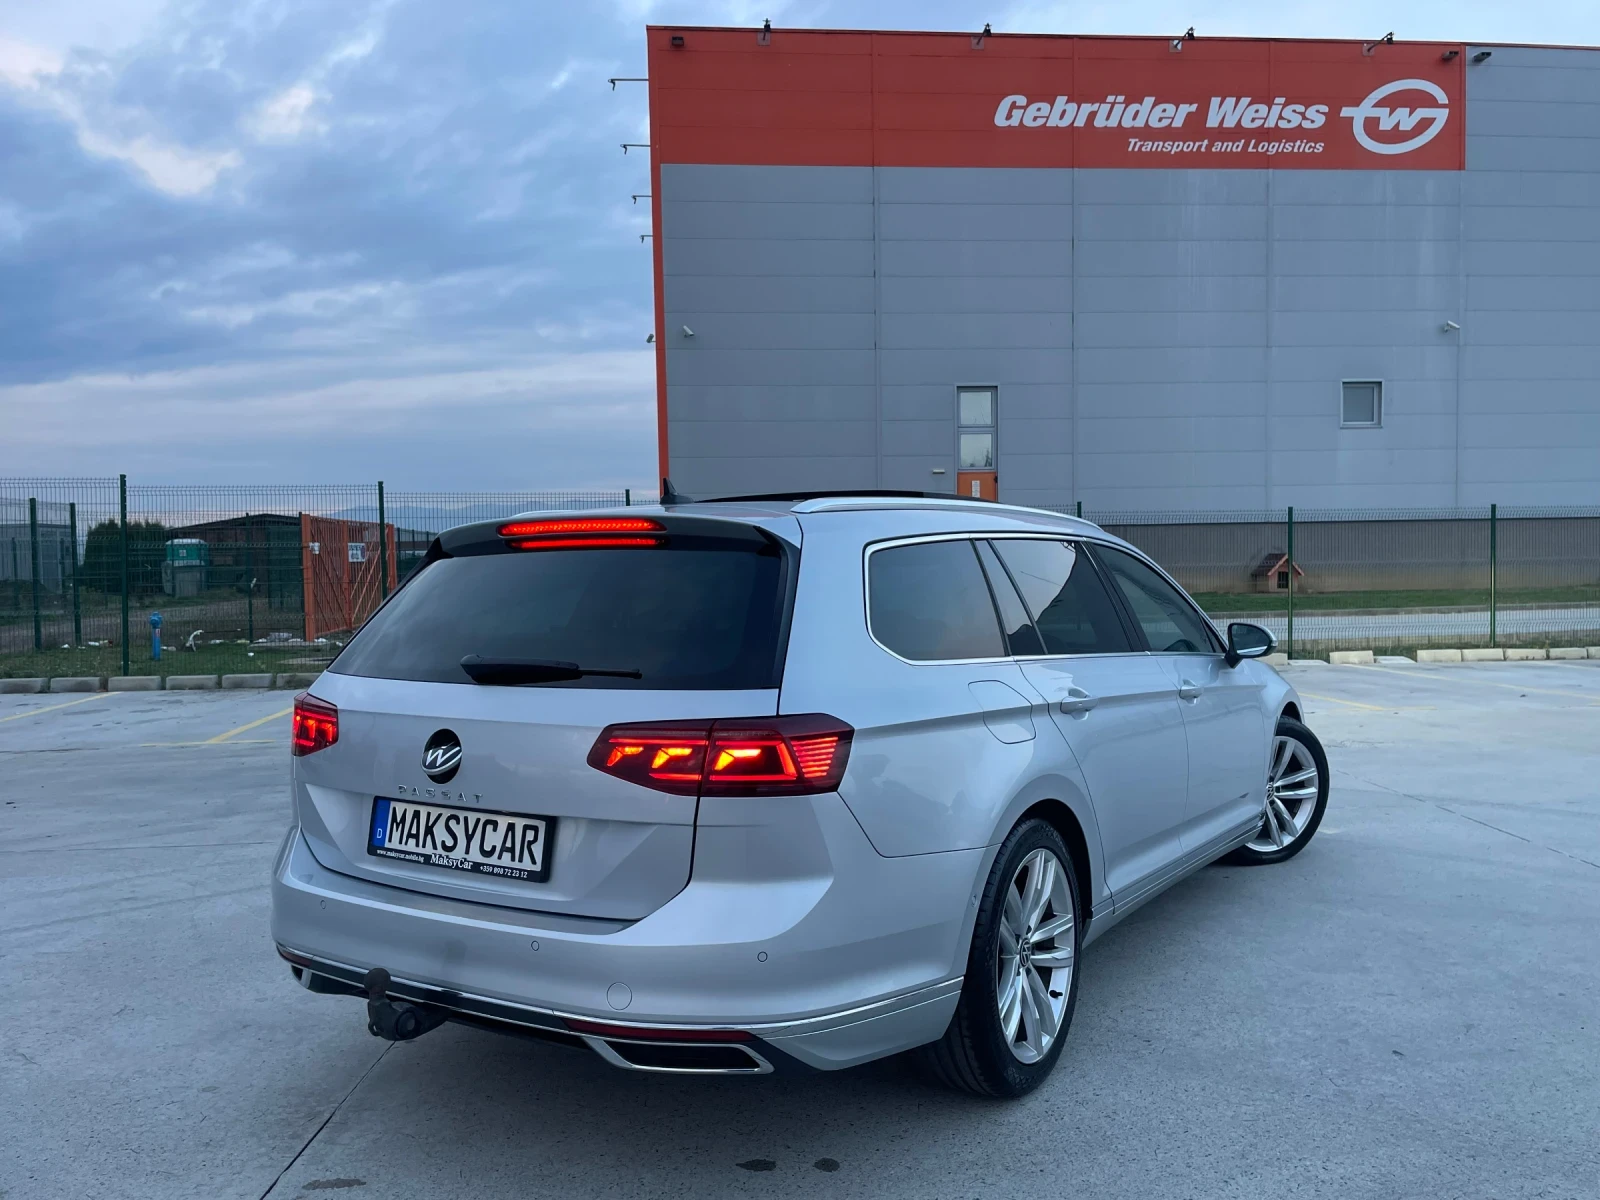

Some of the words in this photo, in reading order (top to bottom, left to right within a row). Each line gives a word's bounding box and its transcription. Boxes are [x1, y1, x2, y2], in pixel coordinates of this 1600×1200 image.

[994, 94, 1198, 128] Gebrüder
[1206, 97, 1329, 129] Weiss
[1127, 138, 1209, 155] Transport
[1212, 140, 1243, 153] and
[1247, 140, 1325, 155] Logistics
[398, 785, 482, 803] PASSAT
[376, 829, 383, 838] D
[388, 806, 540, 866] MAKSYCAR
[430, 853, 473, 869] MaksyCar
[480, 865, 493, 873] +359
[504, 868, 512, 877] 72
[520, 871, 528, 879] 12
